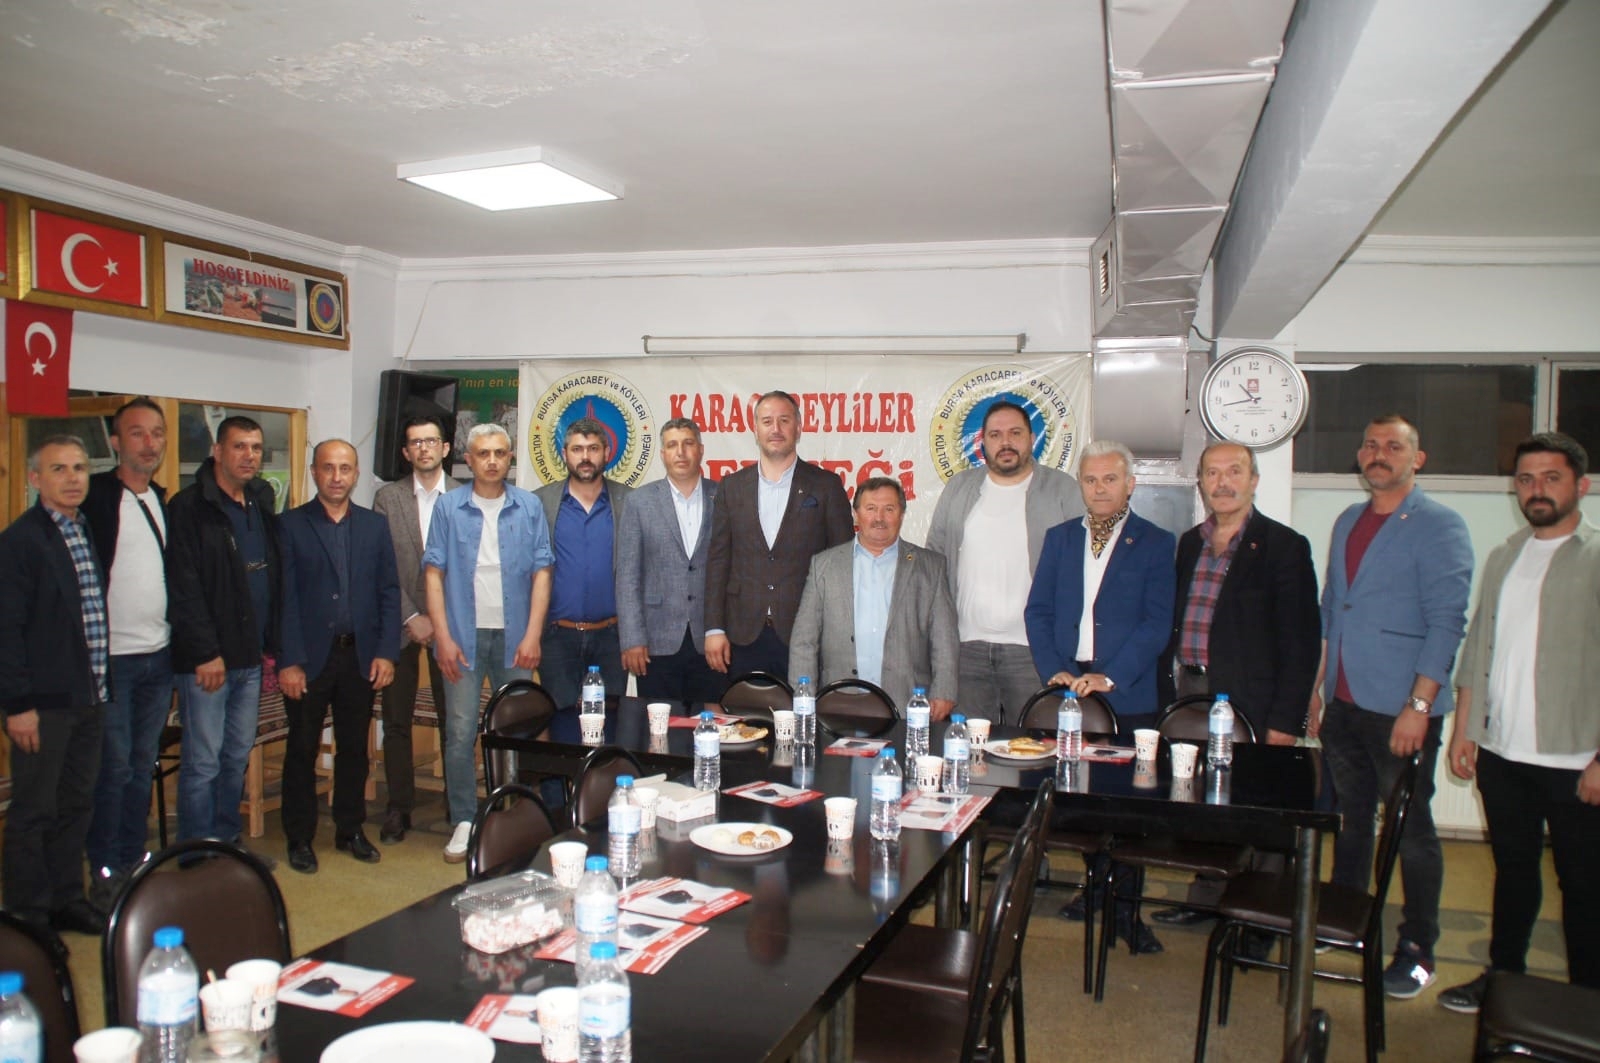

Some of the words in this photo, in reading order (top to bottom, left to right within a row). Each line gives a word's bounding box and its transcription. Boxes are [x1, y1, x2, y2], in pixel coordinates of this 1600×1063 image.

[1233, 366, 1241, 375] 11
[1248, 361, 1260, 371] 12
[1268, 365, 1273, 375] 1
[488, 378, 504, 388] en
[537, 393, 559, 420] BURSA
[557, 375, 610, 396] KARACABEY
[610, 381, 620, 390] ve
[620, 386, 650, 420] KÖYLERİ
[936, 434, 950, 471] KÜLTÜR
[533, 434, 544, 467] KÜLTÜR
[541, 465, 556, 482] DAY
